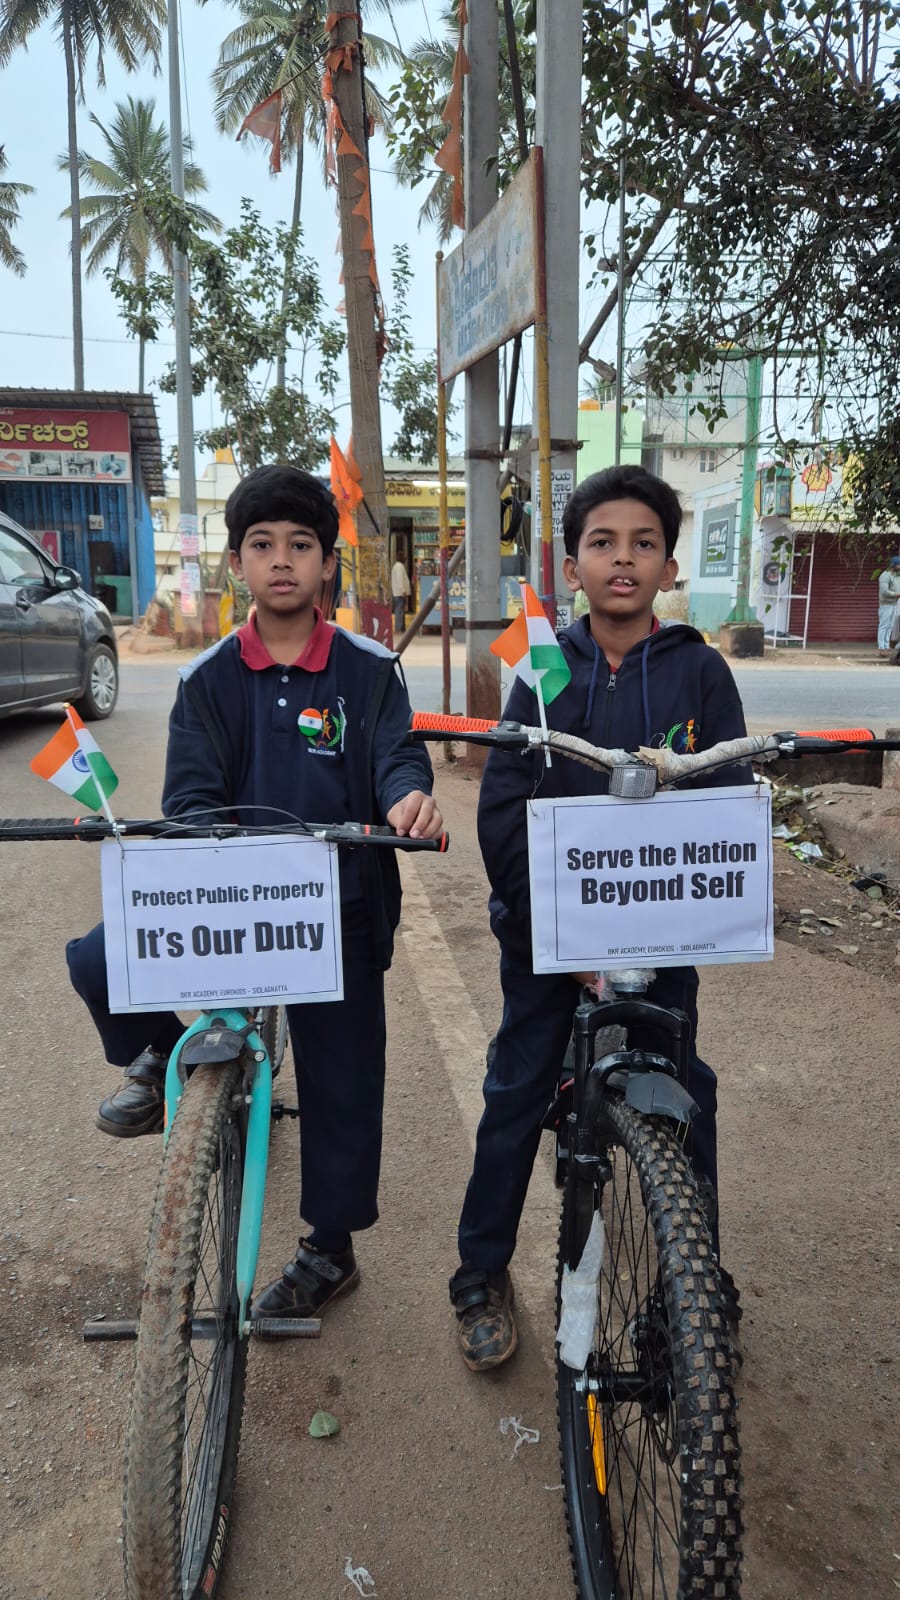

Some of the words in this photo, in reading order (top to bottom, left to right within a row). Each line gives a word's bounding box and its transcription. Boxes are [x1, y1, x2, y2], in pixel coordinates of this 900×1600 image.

[566, 847, 634, 871] Serve
[639, 844, 677, 867] the
[682, 841, 757, 865] Nation
[132, 890, 193, 907] Protect
[196, 886, 249, 905] Public
[252, 881, 324, 901] Property
[581, 873, 684, 906] Beyond
[691, 871, 745, 900] Self
[136, 927, 184, 959] It's
[191, 925, 246, 956] Our
[254, 921, 325, 952] Duty
[647, 945, 675, 953] EUROKIDS
[680, 943, 716, 952] SIDLAGHATTA
[220, 988, 246, 997] EUROKIDS
